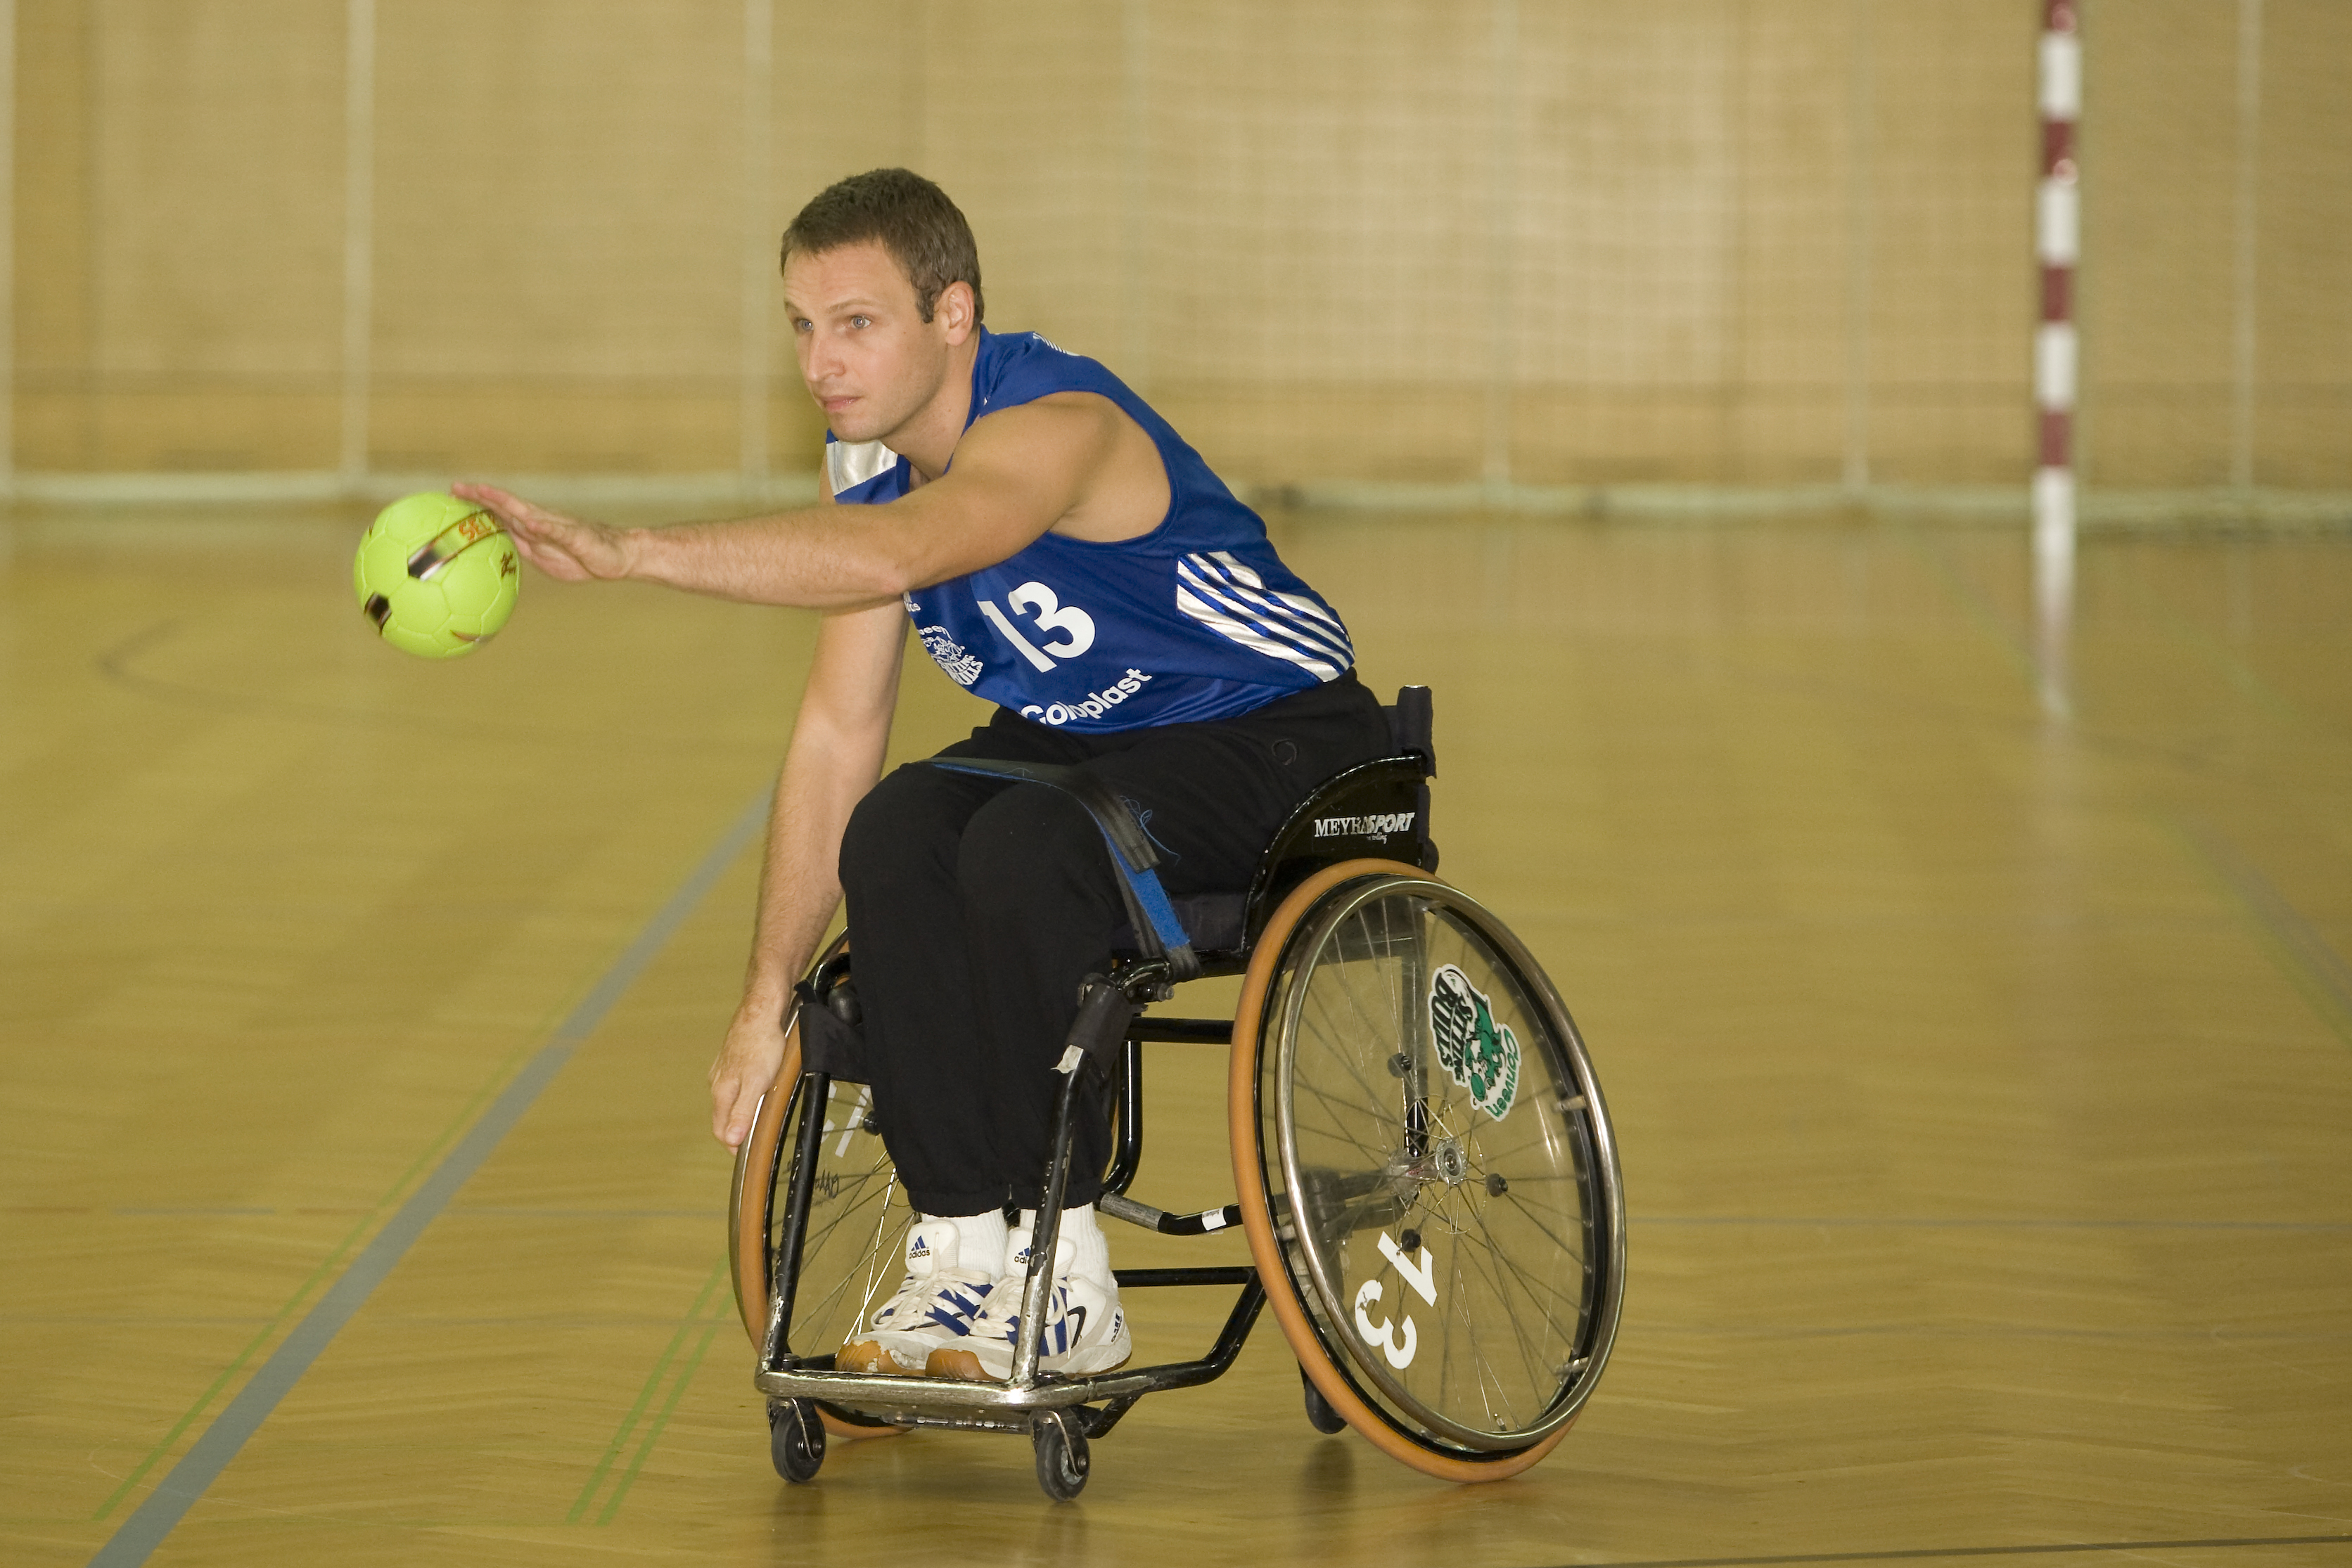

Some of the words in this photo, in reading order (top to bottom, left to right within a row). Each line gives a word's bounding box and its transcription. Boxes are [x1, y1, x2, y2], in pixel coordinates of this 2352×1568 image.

[977, 581, 1095, 673] 13
[1018, 668, 1153, 726] Coloplast
[1432, 973, 1458, 1067] BULLS
[1451, 992, 1474, 1084] SITTING
[1485, 1028, 1519, 1118] Conveen
[1014, 1255, 1028, 1264] adi
[1355, 1230, 1438, 1370] 13
